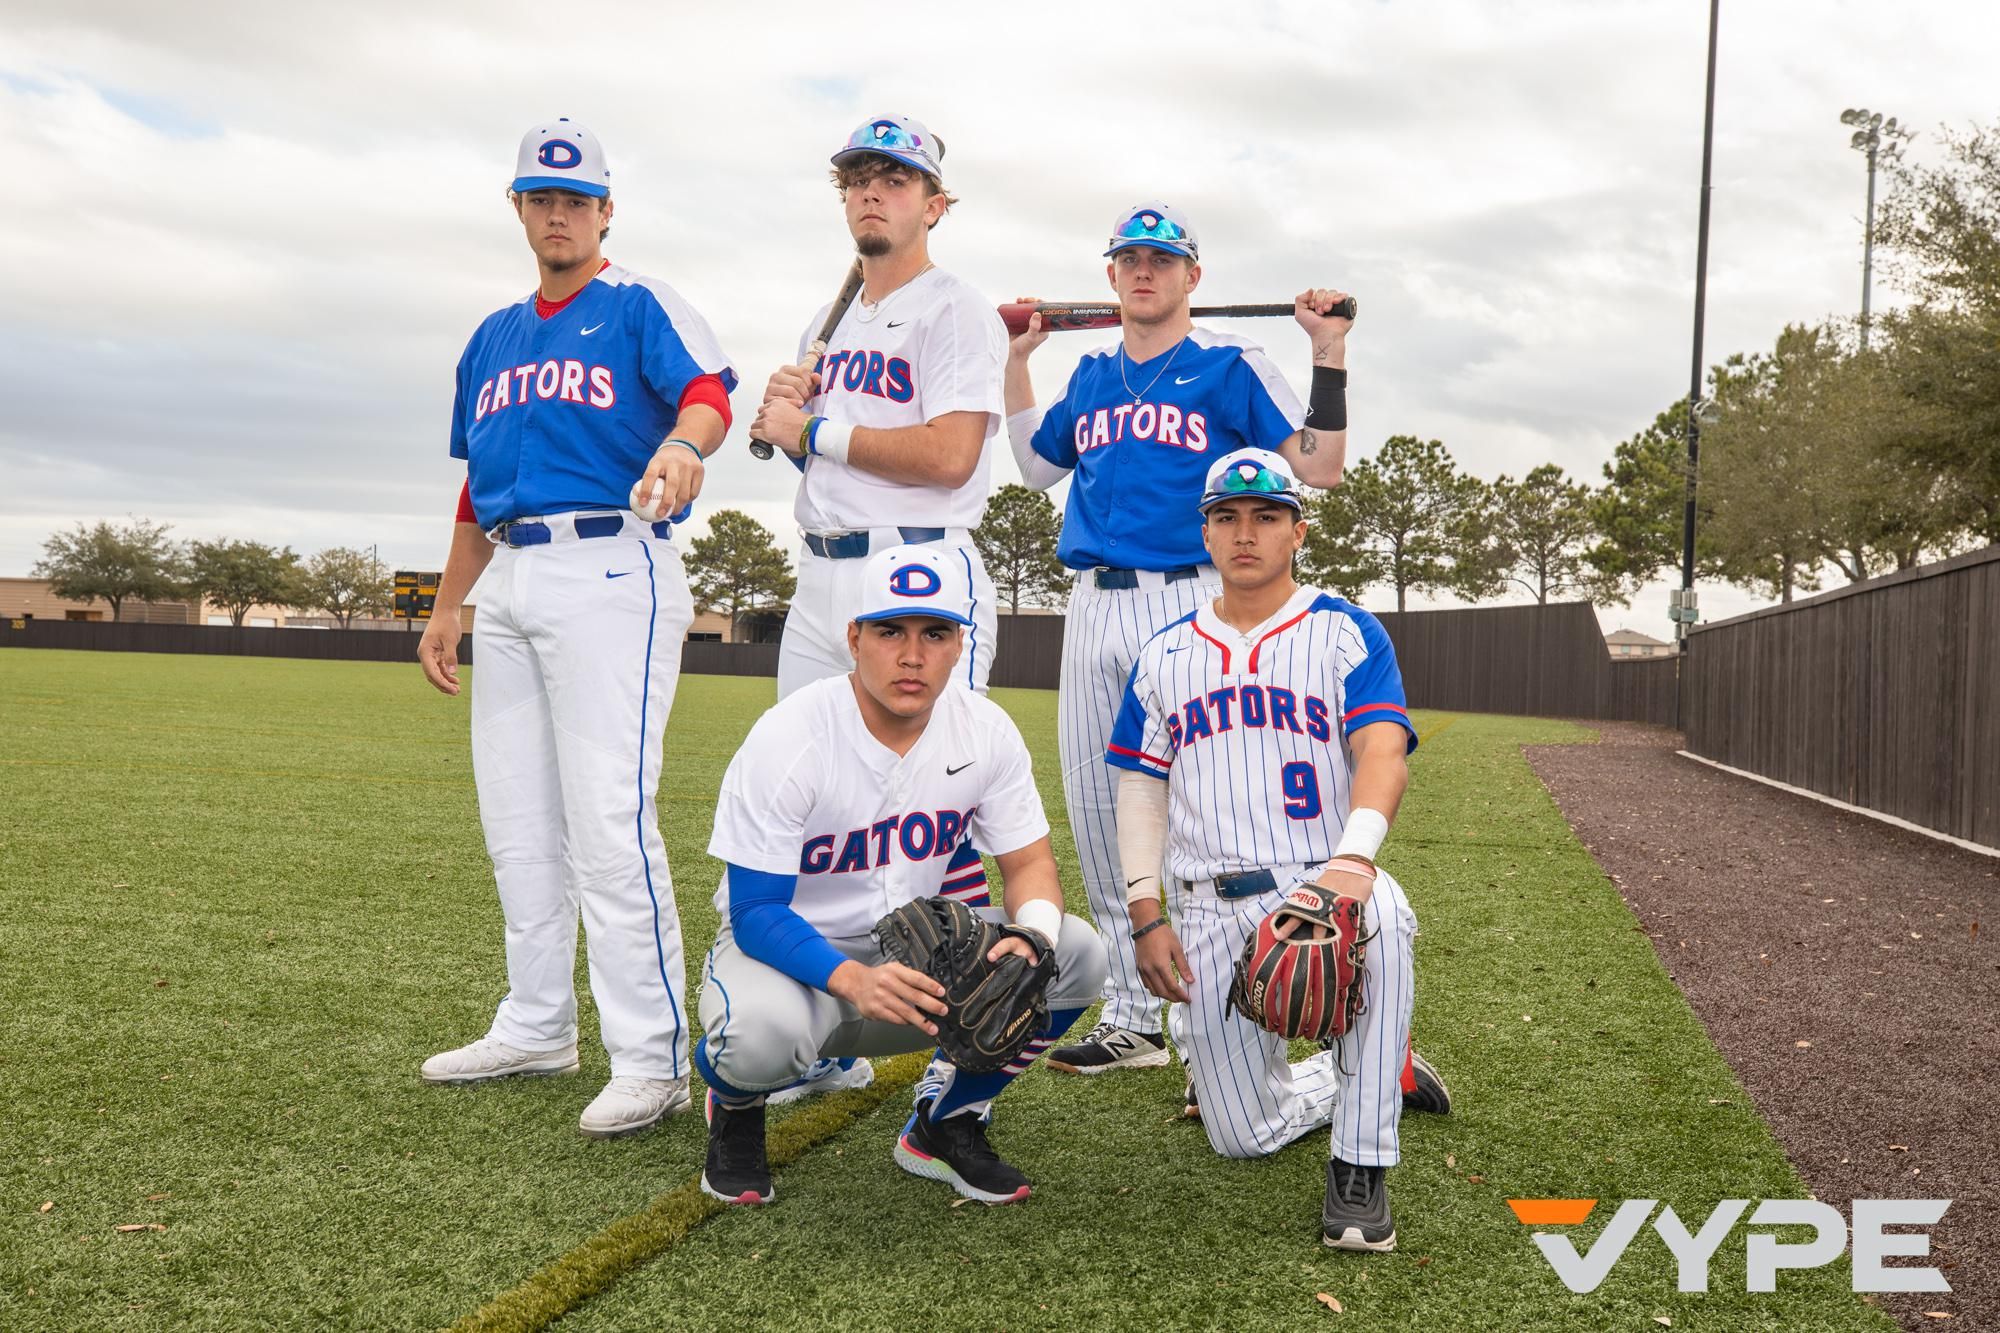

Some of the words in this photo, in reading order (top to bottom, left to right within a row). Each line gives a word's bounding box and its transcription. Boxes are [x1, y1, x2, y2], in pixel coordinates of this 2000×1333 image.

[538, 139, 582, 169] D
[474, 359, 616, 422] GATORS
[1074, 402, 1209, 455] GATORS
[889, 563, 942, 598] D
[1281, 760, 1323, 821] 9
